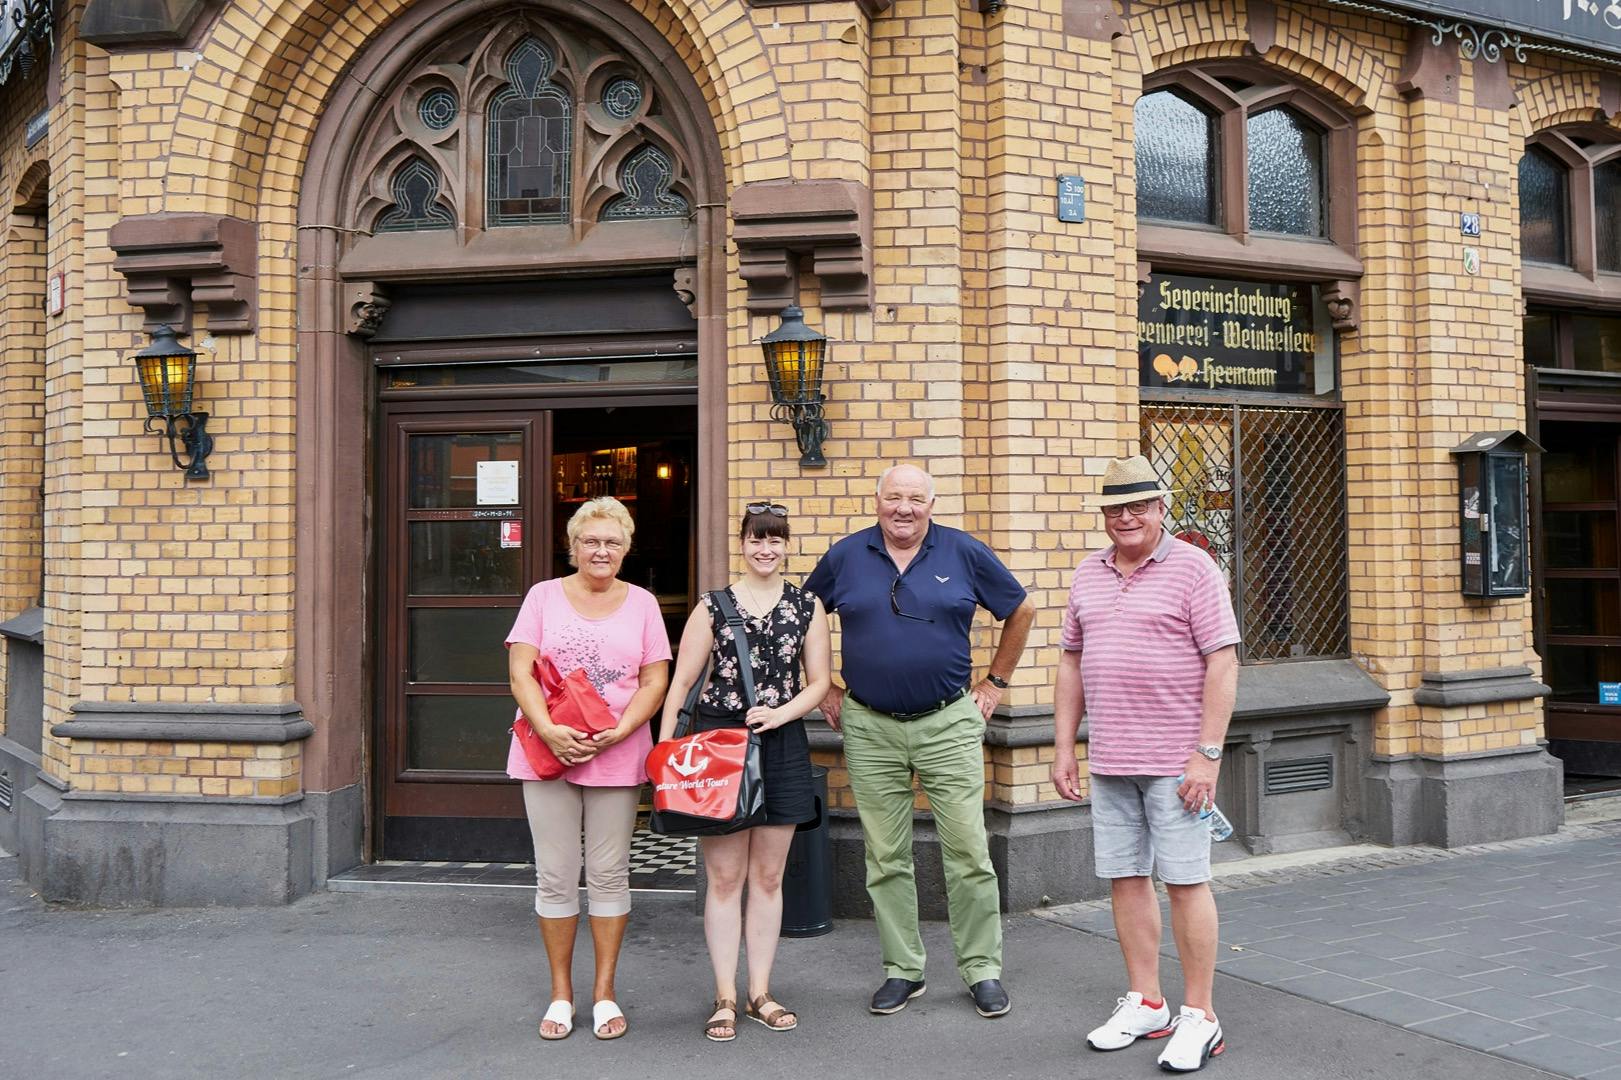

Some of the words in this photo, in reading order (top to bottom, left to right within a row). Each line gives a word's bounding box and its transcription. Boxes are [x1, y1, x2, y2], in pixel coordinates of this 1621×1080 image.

[1463, 215, 1479, 234] 28
[1137, 318, 1209, 347] rennerei
[1222, 320, 1321, 353] Weinkellere
[1203, 357, 1277, 389] Hermann
[679, 779, 704, 790] World
[705, 777, 729, 788] Tours
